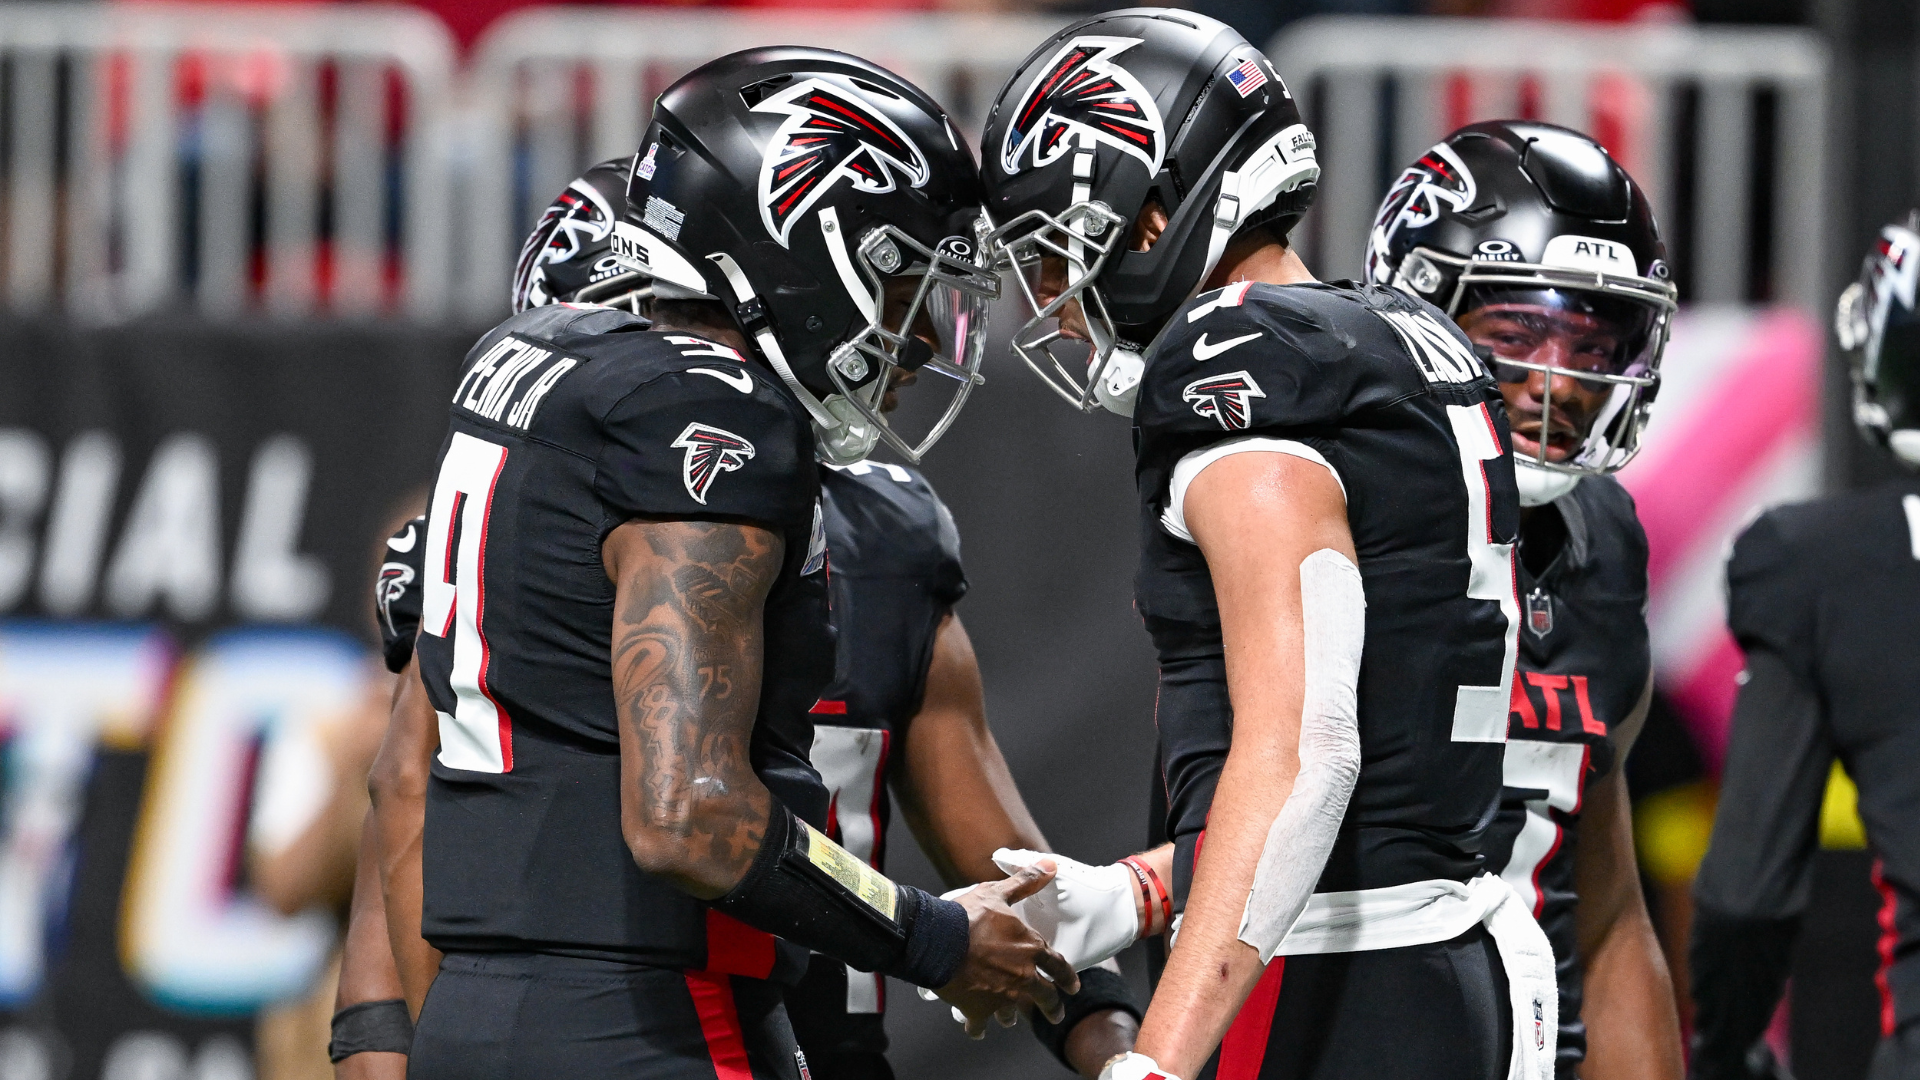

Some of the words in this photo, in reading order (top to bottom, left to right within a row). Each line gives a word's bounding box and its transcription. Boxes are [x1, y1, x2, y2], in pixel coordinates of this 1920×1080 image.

[1575, 241, 1619, 260] ATL
[452, 336, 553, 422] PENIX
[507, 357, 578, 430] JR
[423, 431, 514, 774] 9
[1446, 400, 1521, 742] 5
[1509, 669, 1608, 737] ATL
